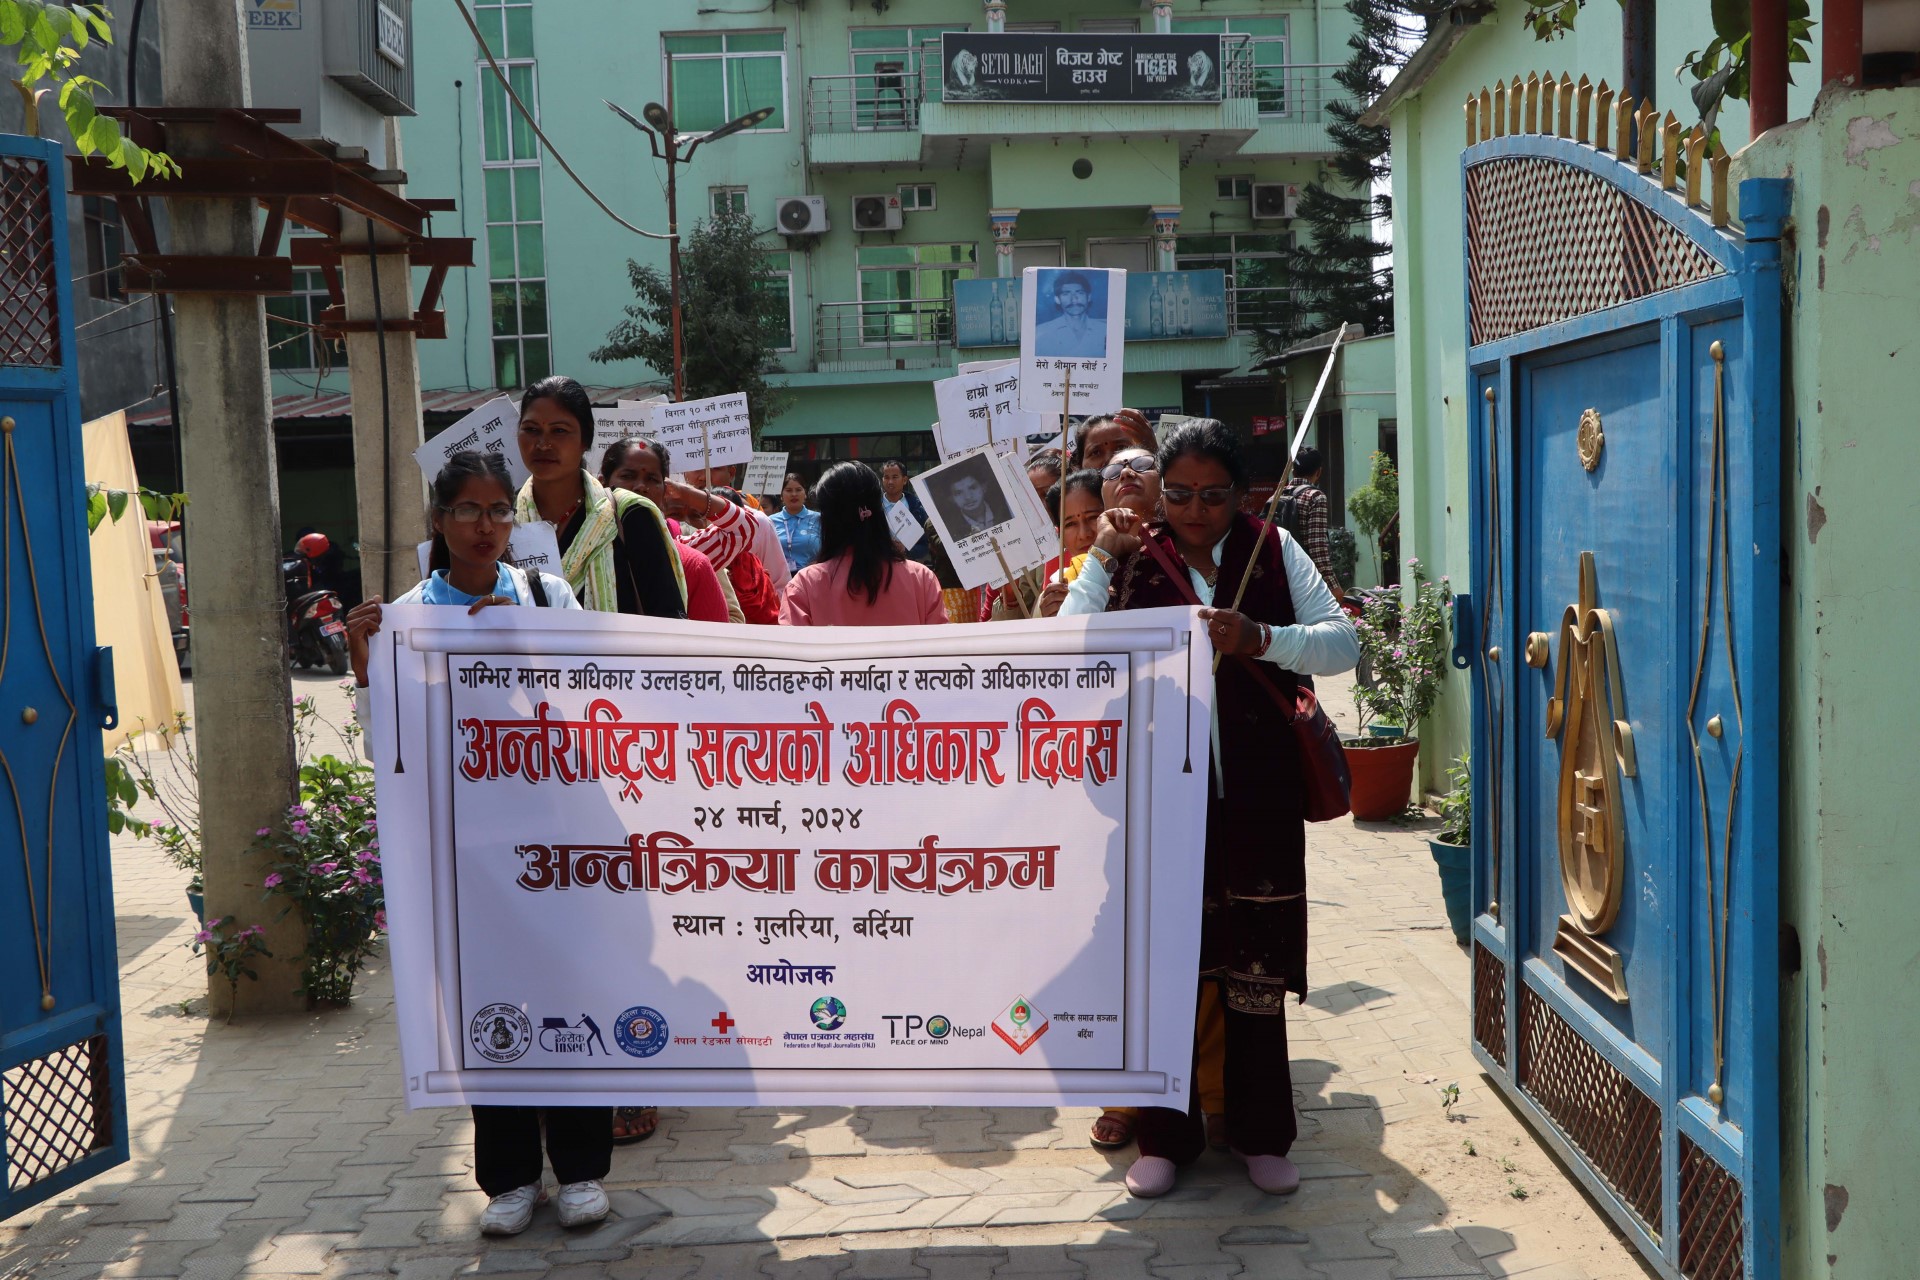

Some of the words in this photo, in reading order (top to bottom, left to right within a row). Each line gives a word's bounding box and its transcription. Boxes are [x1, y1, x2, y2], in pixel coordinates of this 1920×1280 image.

[248, 11, 293, 26] EEK
[981, 52, 1010, 75] SETO
[1014, 52, 1043, 75] BAGH
[1056, 47, 1093, 66] विजय
[1097, 48, 1123, 66] गेष्ट
[1136, 52, 1153, 60] BRING
[1154, 52, 1165, 60] OUT
[1134, 59, 1178, 76] TIGER
[1072, 69, 1107, 84] हाउस
[1146, 75, 1154, 83] IN
[1155, 75, 1167, 83] YOU
[1036, 359, 1049, 370] मेरो
[966, 383, 989, 401] हाम्रो
[994, 376, 1018, 393] मान्छे
[689, 406, 701, 416] १०
[481, 416, 503, 435] आम
[716, 446, 727, 455] गर
[458, 660, 512, 689] गम्भिर
[517, 668, 562, 690] मानव
[567, 662, 636, 691] अधिकार
[840, 665, 893, 694] मर्यादा
[897, 669, 910, 692] र
[914, 663, 975, 692] सत्यको
[981, 661, 1071, 690] अधिकारका
[1076, 660, 1117, 689] लागि
[687, 700, 835, 790] सत्यको
[842, 698, 1009, 787] अधिकार
[1015, 697, 1123, 789] दिवस
[694, 806, 724, 831] २४
[737, 800, 787, 833] मार्च,
[801, 807, 863, 832] २०२४
[814, 834, 1061, 897] कार्यक्रम
[672, 914, 726, 937] स्थान
[753, 908, 840, 945] गुलरिया,
[852, 909, 915, 940] बर्दिया
[746, 958, 837, 986] आयोजक
[1053, 1012, 1076, 1023] नागरिक
[1077, 1014, 1095, 1023] समाज
[673, 1035, 697, 1046] नेपाल
[702, 1035, 731, 1046] रेडक्रस
[736, 1034, 773, 1046] सोसाइटी
[783, 1031, 808, 1041] नेपाल
[810, 1032, 841, 1041] पत्रकार
[952, 1026, 985, 1040] Nepal
[783, 1041, 809, 1049] Federation
[817, 1041, 833, 1050] Nepali
[832, 1041, 861, 1049] Journalists
[861, 1041, 876, 1049] (FNJ)
